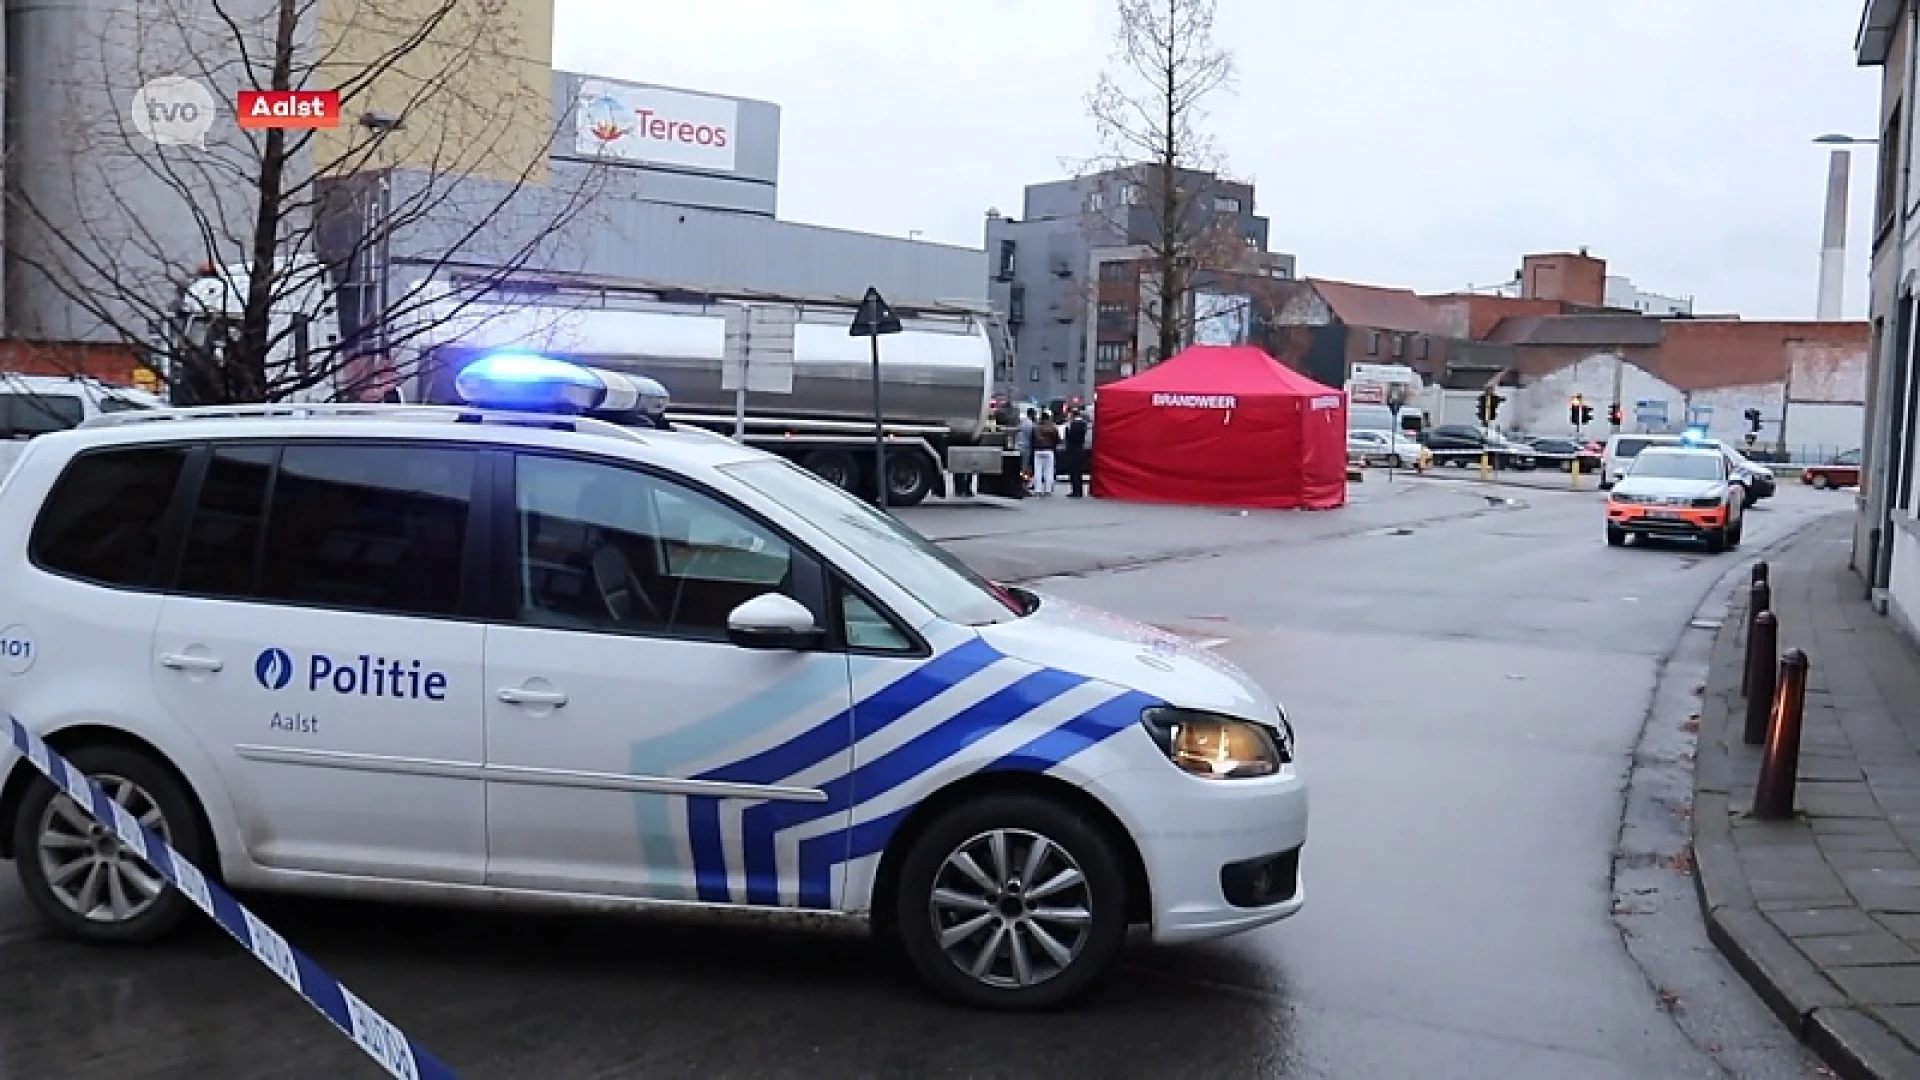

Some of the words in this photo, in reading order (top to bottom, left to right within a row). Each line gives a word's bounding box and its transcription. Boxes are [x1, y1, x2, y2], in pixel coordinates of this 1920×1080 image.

[635, 108, 726, 147] Tereos
[309, 655, 447, 701] Politie
[270, 712, 318, 733] Aalst
